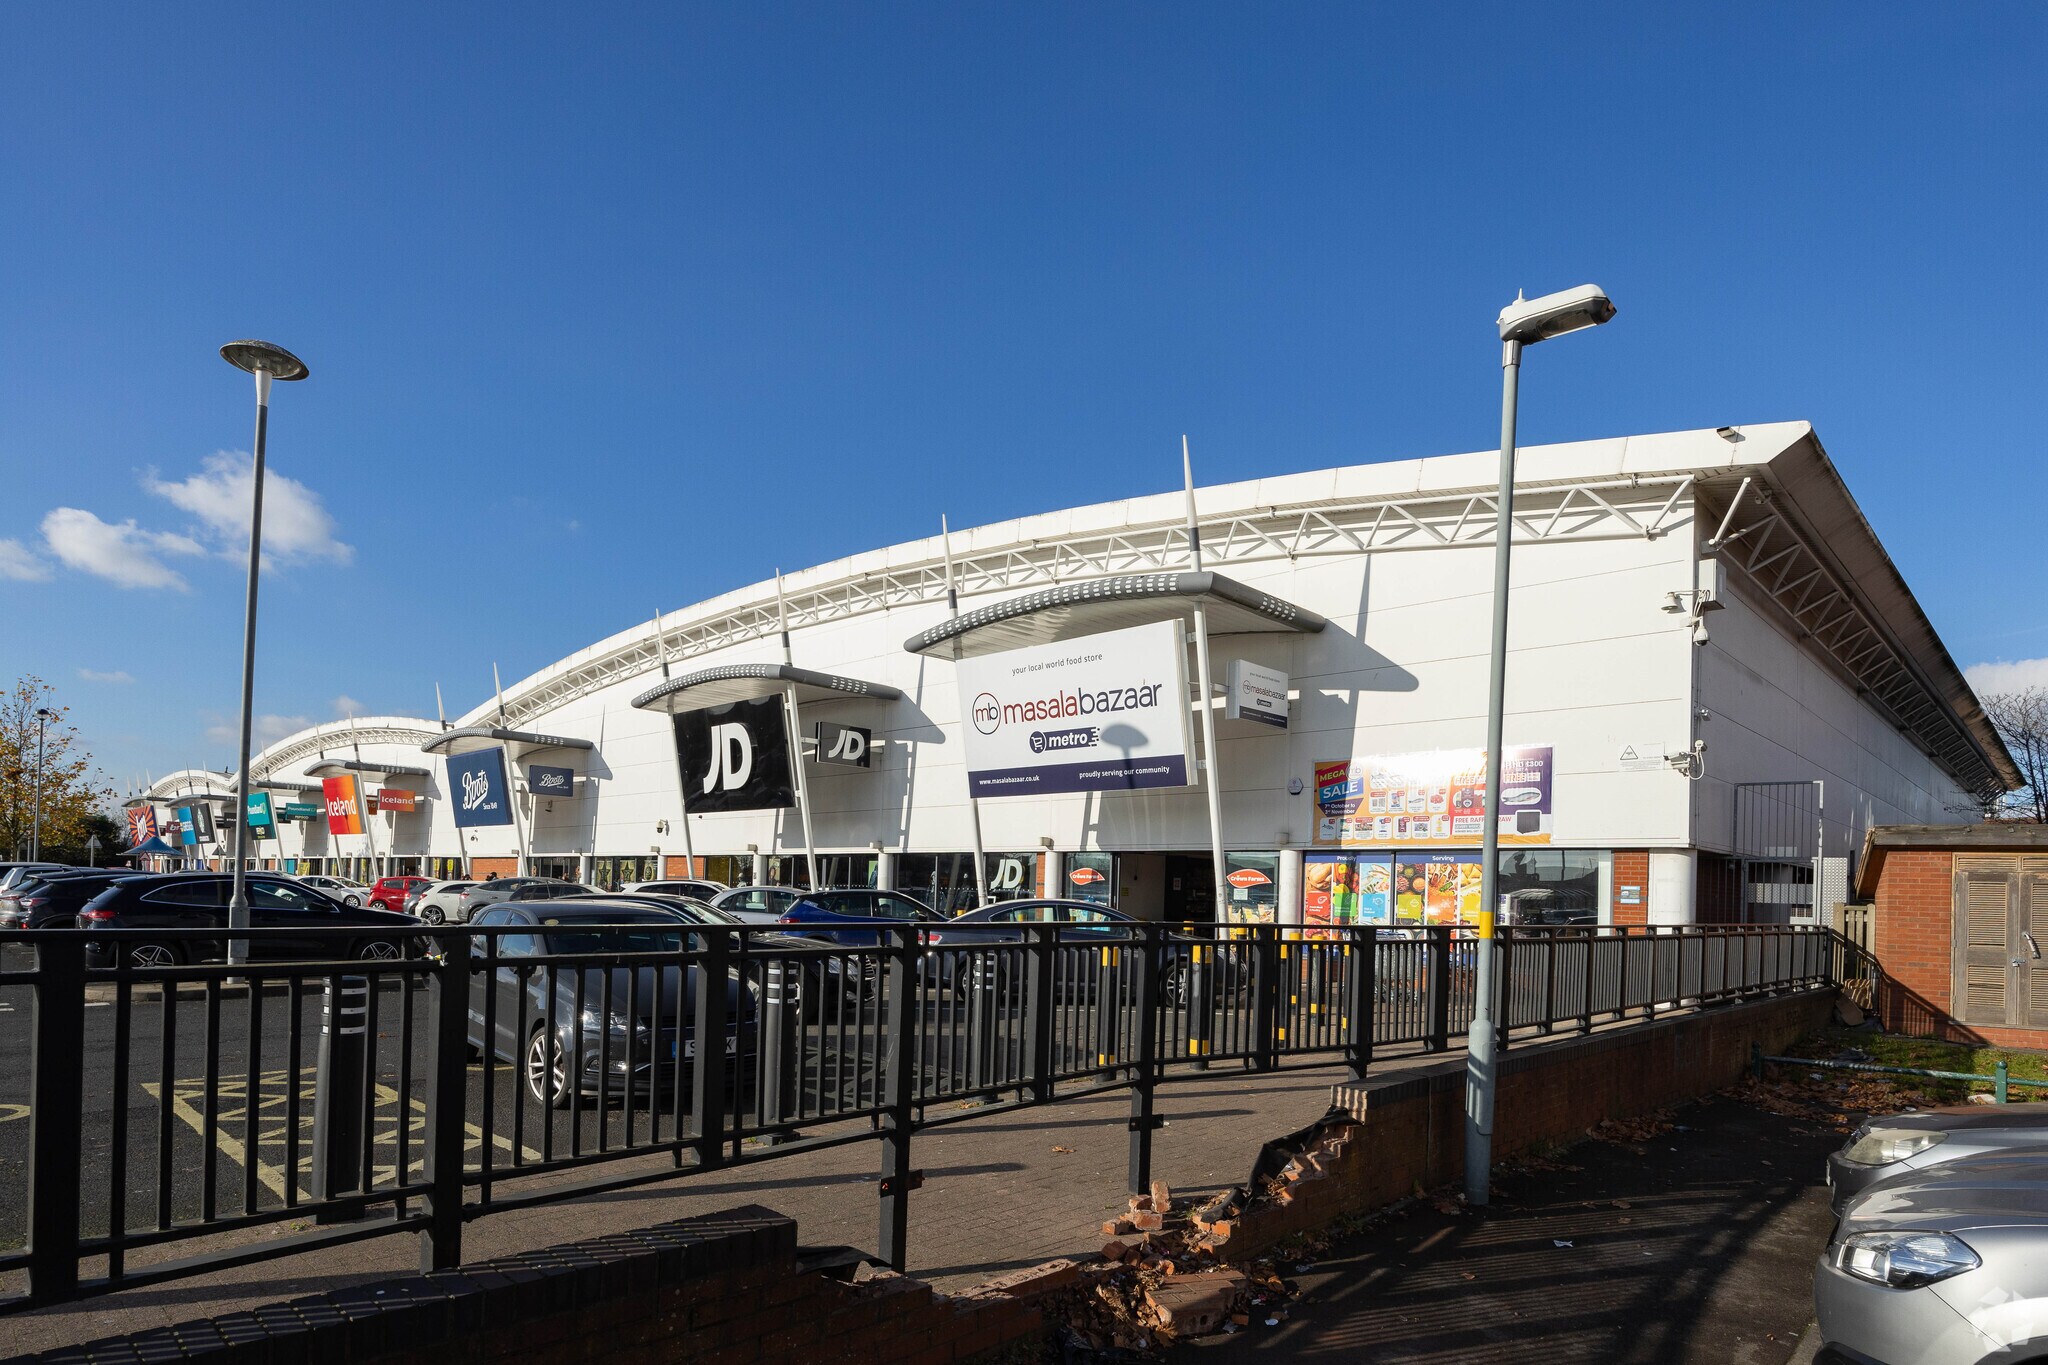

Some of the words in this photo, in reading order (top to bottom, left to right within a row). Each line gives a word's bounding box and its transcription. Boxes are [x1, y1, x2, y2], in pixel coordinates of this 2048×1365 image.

[1012, 666, 1026, 676] your
[1028, 662, 1044, 672] local
[1045, 658, 1064, 670] world
[1066, 656, 1082, 666] food
[1084, 653, 1102, 663] store
[975, 702, 998, 722] mb
[1003, 683, 1162, 724] masalabazaar
[828, 729, 865, 760] JD
[1049, 732, 1088, 748] metro
[703, 722, 752, 794] JD
[539, 774, 564, 787] Boots
[979, 774, 1040, 785] www.masalabazaar.co.uk
[1080, 769, 1101, 779] proudly
[1102, 768, 1124, 778] serving
[1136, 766, 1170, 776] community
[1320, 769, 1345, 782] MEGA
[462, 770, 488, 810] Boots
[1323, 781, 1358, 798] SALE
[326, 796, 357, 816] Iceland
[990, 859, 1022, 888] JD
